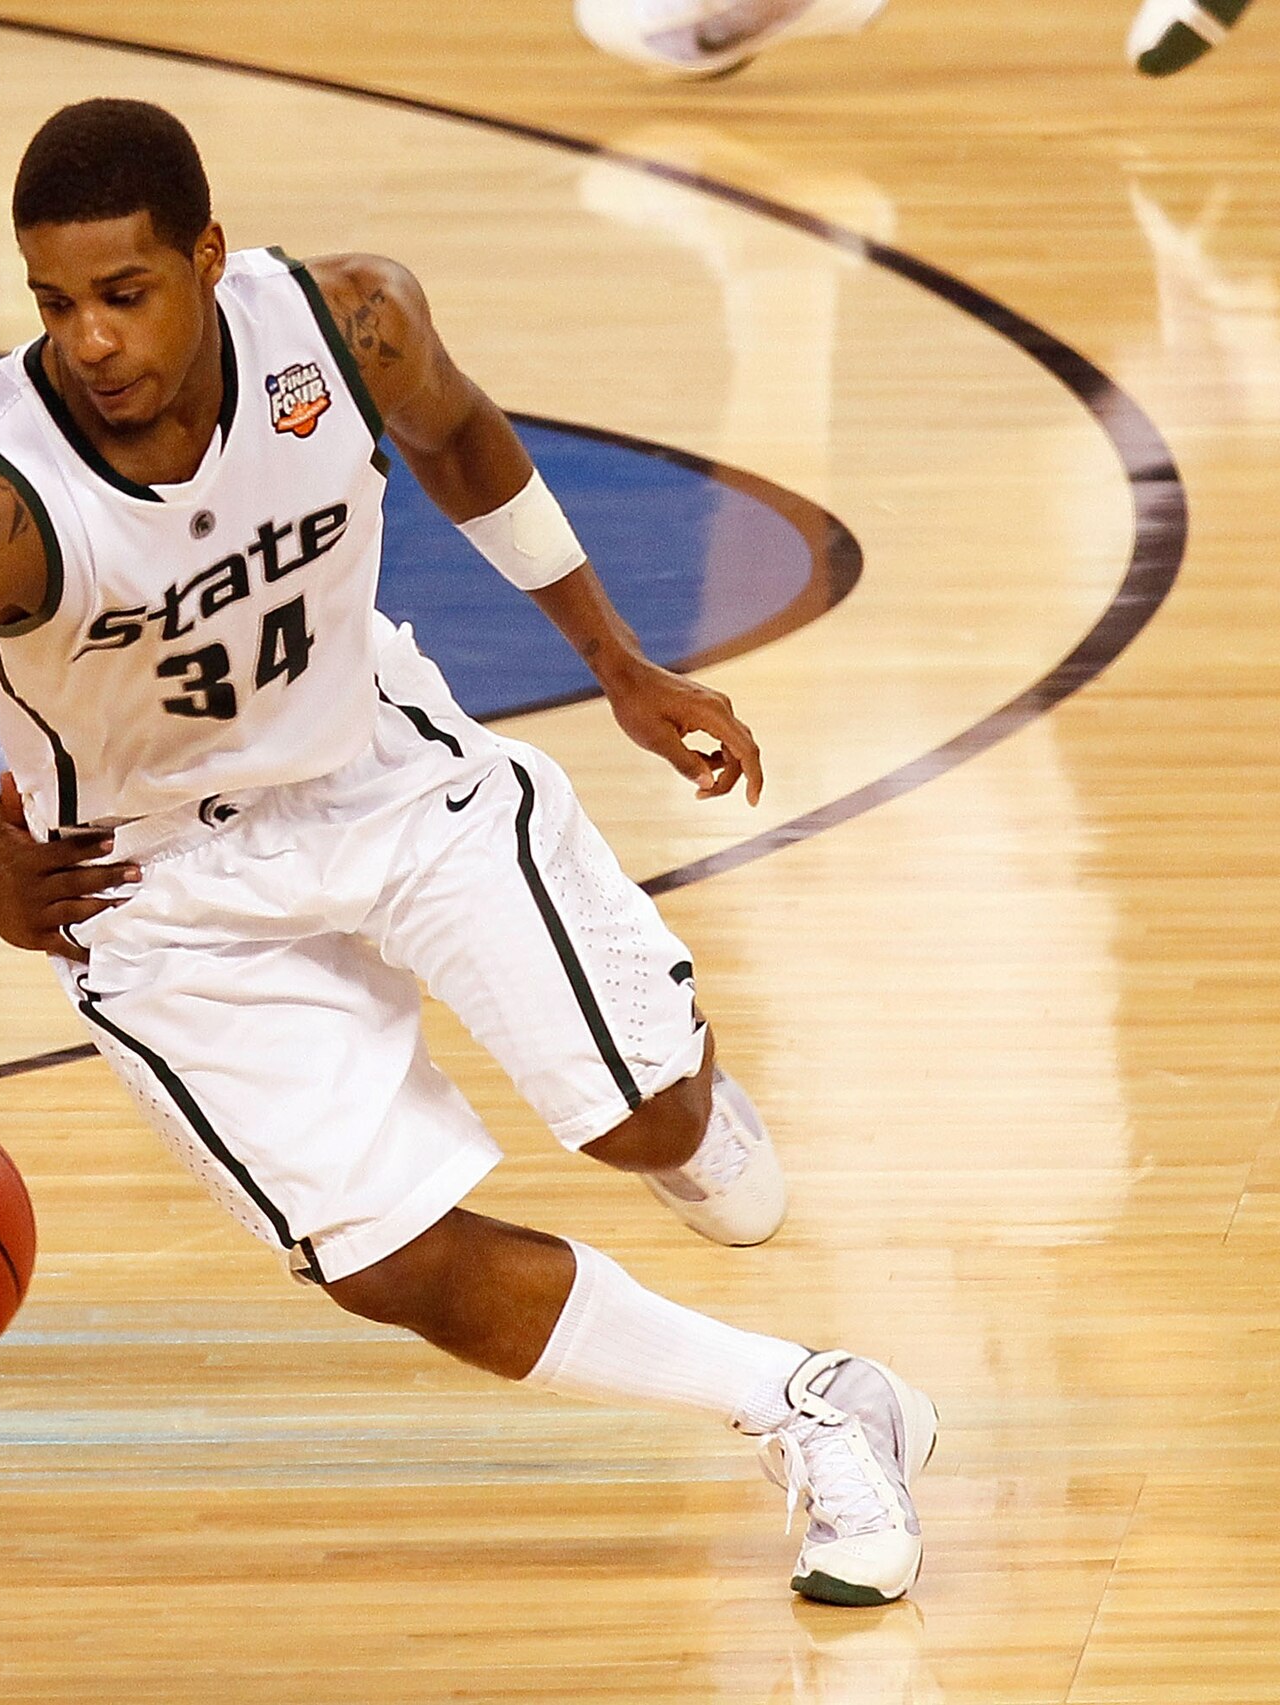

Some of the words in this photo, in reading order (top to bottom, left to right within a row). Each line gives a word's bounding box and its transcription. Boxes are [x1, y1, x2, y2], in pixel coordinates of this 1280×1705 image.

[271, 378, 327, 424] FOUR
[277, 364, 320, 394] FINAL
[72, 502, 348, 662] state
[155, 593, 315, 721] 34
